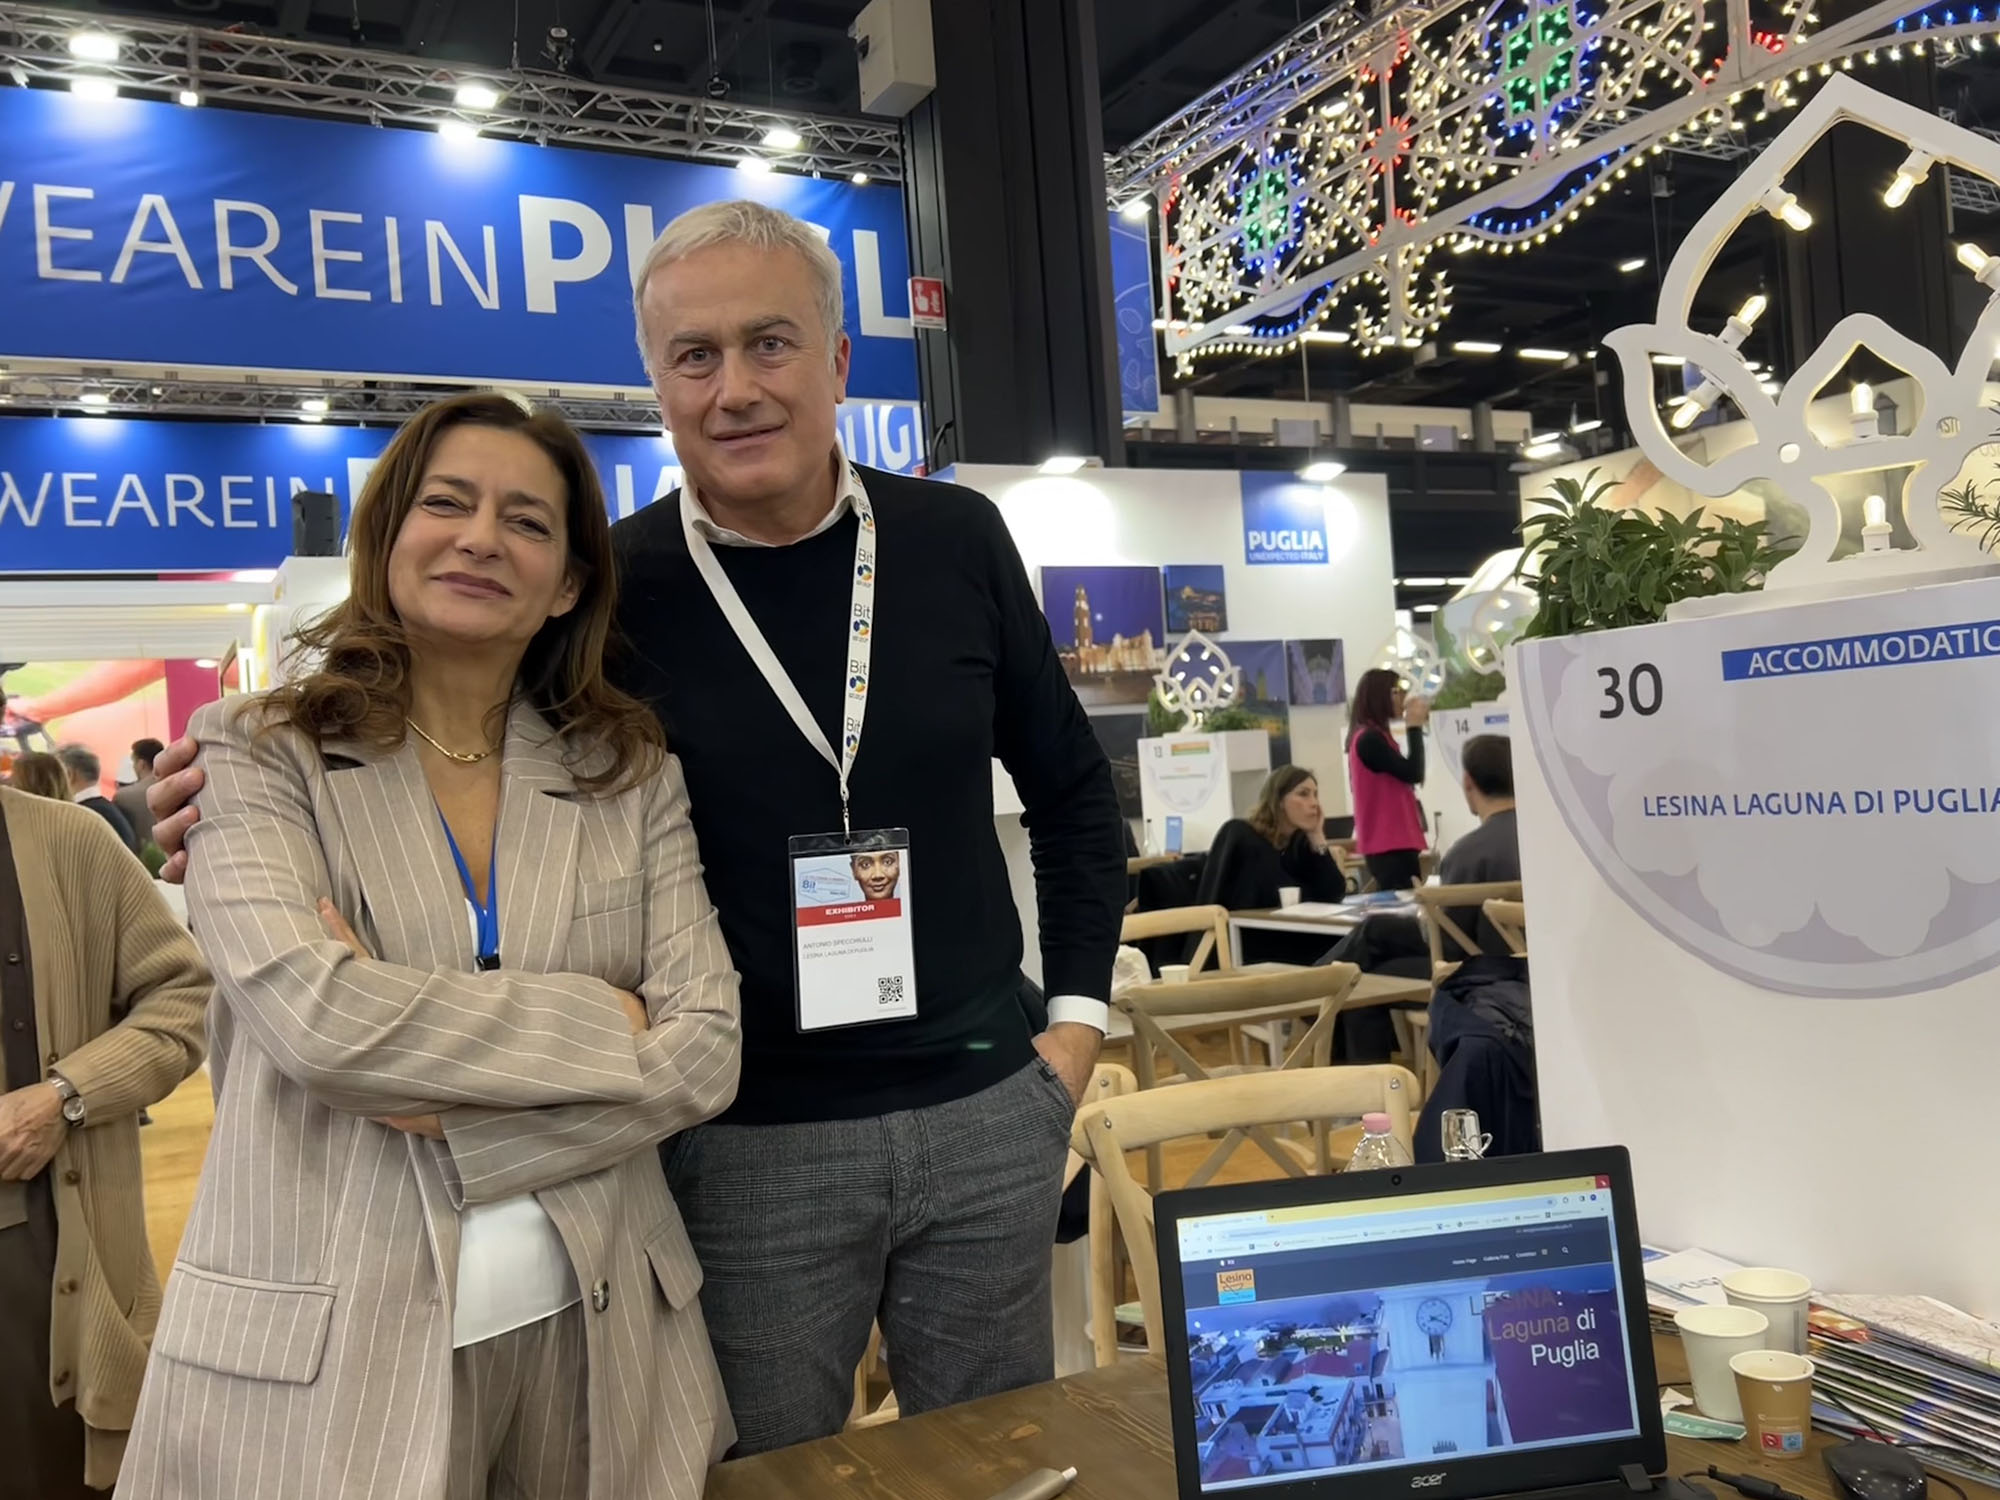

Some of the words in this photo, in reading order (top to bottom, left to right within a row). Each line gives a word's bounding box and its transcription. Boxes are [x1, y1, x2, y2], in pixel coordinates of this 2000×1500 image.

[1247, 530, 1325, 551] PUGLIA
[857, 547, 874, 564] Bit
[853, 602, 871, 620] Bit
[849, 659, 868, 676] Bit
[1597, 662, 1663, 719] 30
[845, 717, 861, 734] Bit
[1455, 718, 1470, 735] 14
[1643, 794, 1727, 817] LESINA
[1733, 791, 1847, 816] LAGUNA
[1854, 790, 1884, 815] DI
[825, 904, 875, 916] EXHIBITOR
[1219, 1272, 1252, 1284] Lesina
[1488, 1315, 1570, 1343] Laguna
[1576, 1308, 1596, 1331] di
[1531, 1339, 1600, 1368] Puglia
[1410, 1472, 1447, 1489] acer
